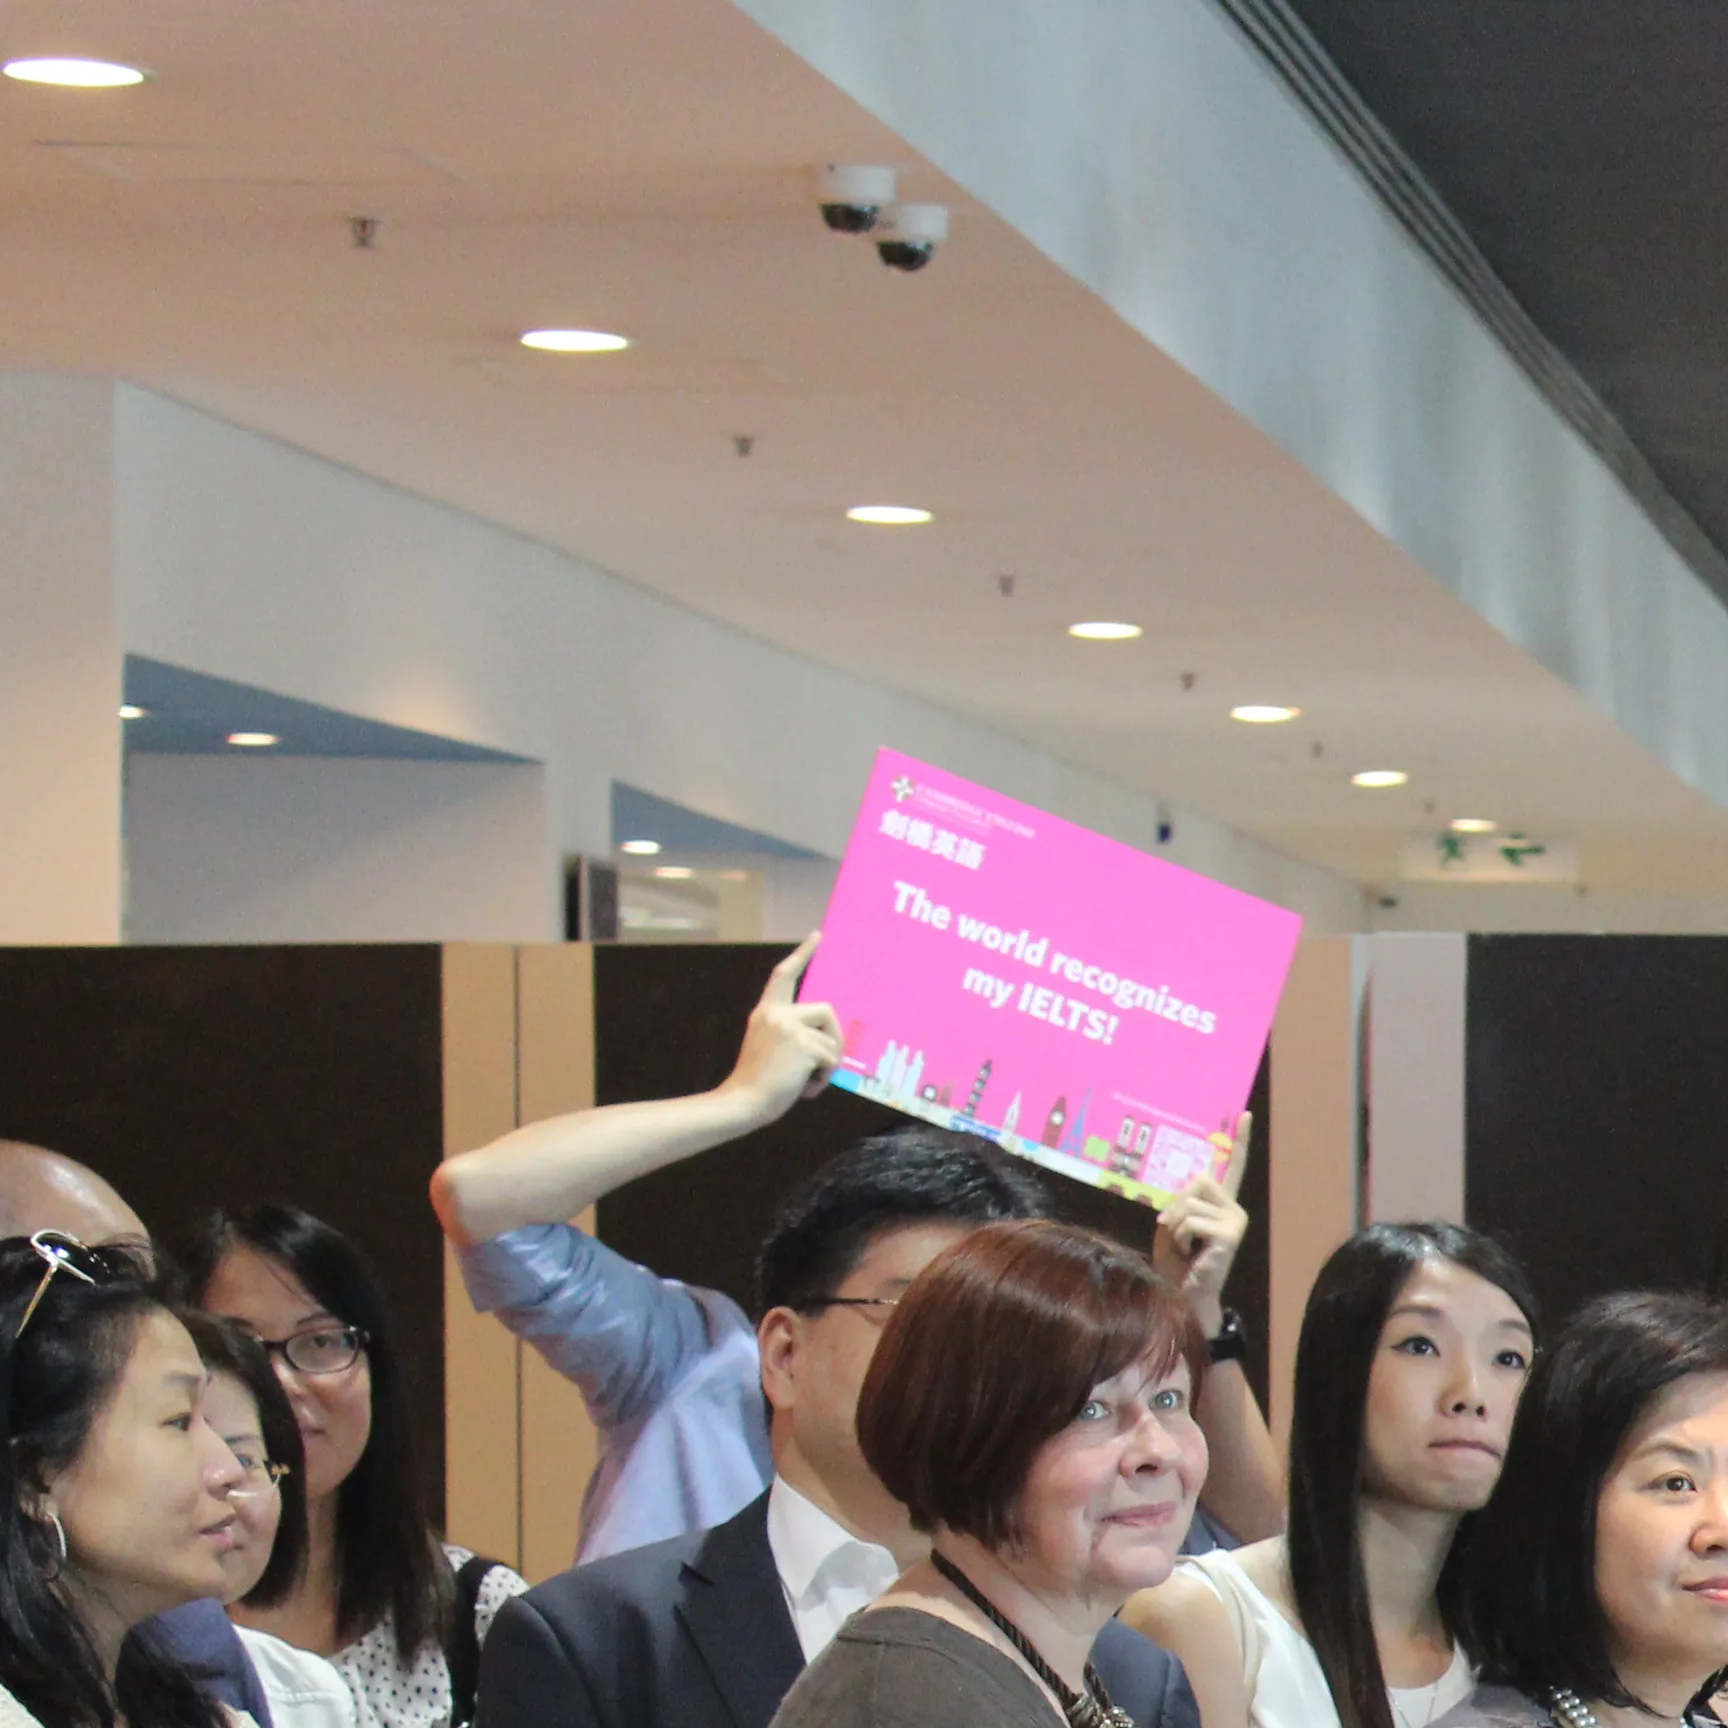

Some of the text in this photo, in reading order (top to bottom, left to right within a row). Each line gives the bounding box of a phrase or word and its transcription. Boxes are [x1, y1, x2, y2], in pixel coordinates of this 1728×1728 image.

[893, 881, 1217, 1035] The world recognizes
[962, 967, 1119, 1044] my IELTS!
